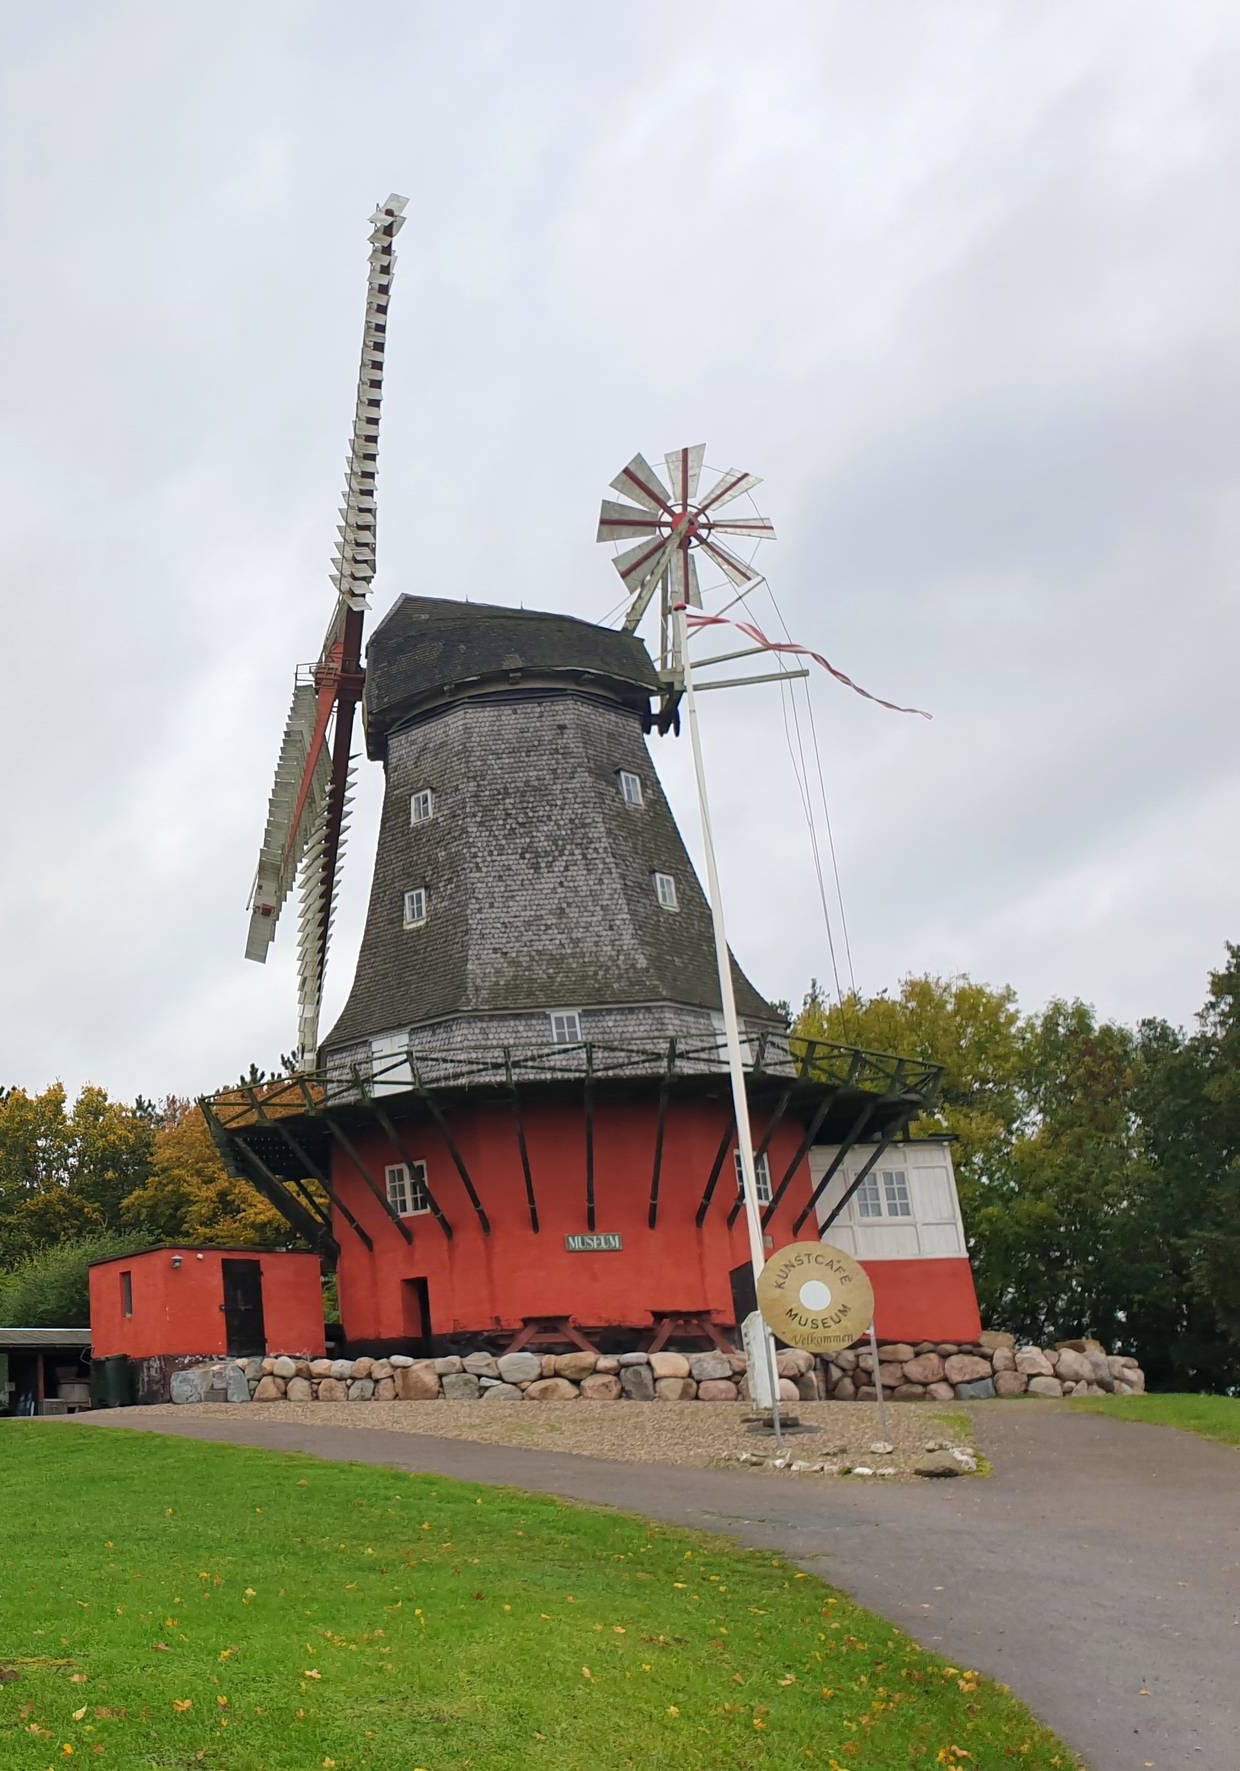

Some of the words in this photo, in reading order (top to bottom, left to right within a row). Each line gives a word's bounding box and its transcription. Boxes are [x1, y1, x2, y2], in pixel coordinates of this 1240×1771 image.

[568, 1235, 620, 1249] MUSEUM
[786, 1303, 852, 1329] MUSEUM
[793, 1332, 854, 1346] Velkommen
